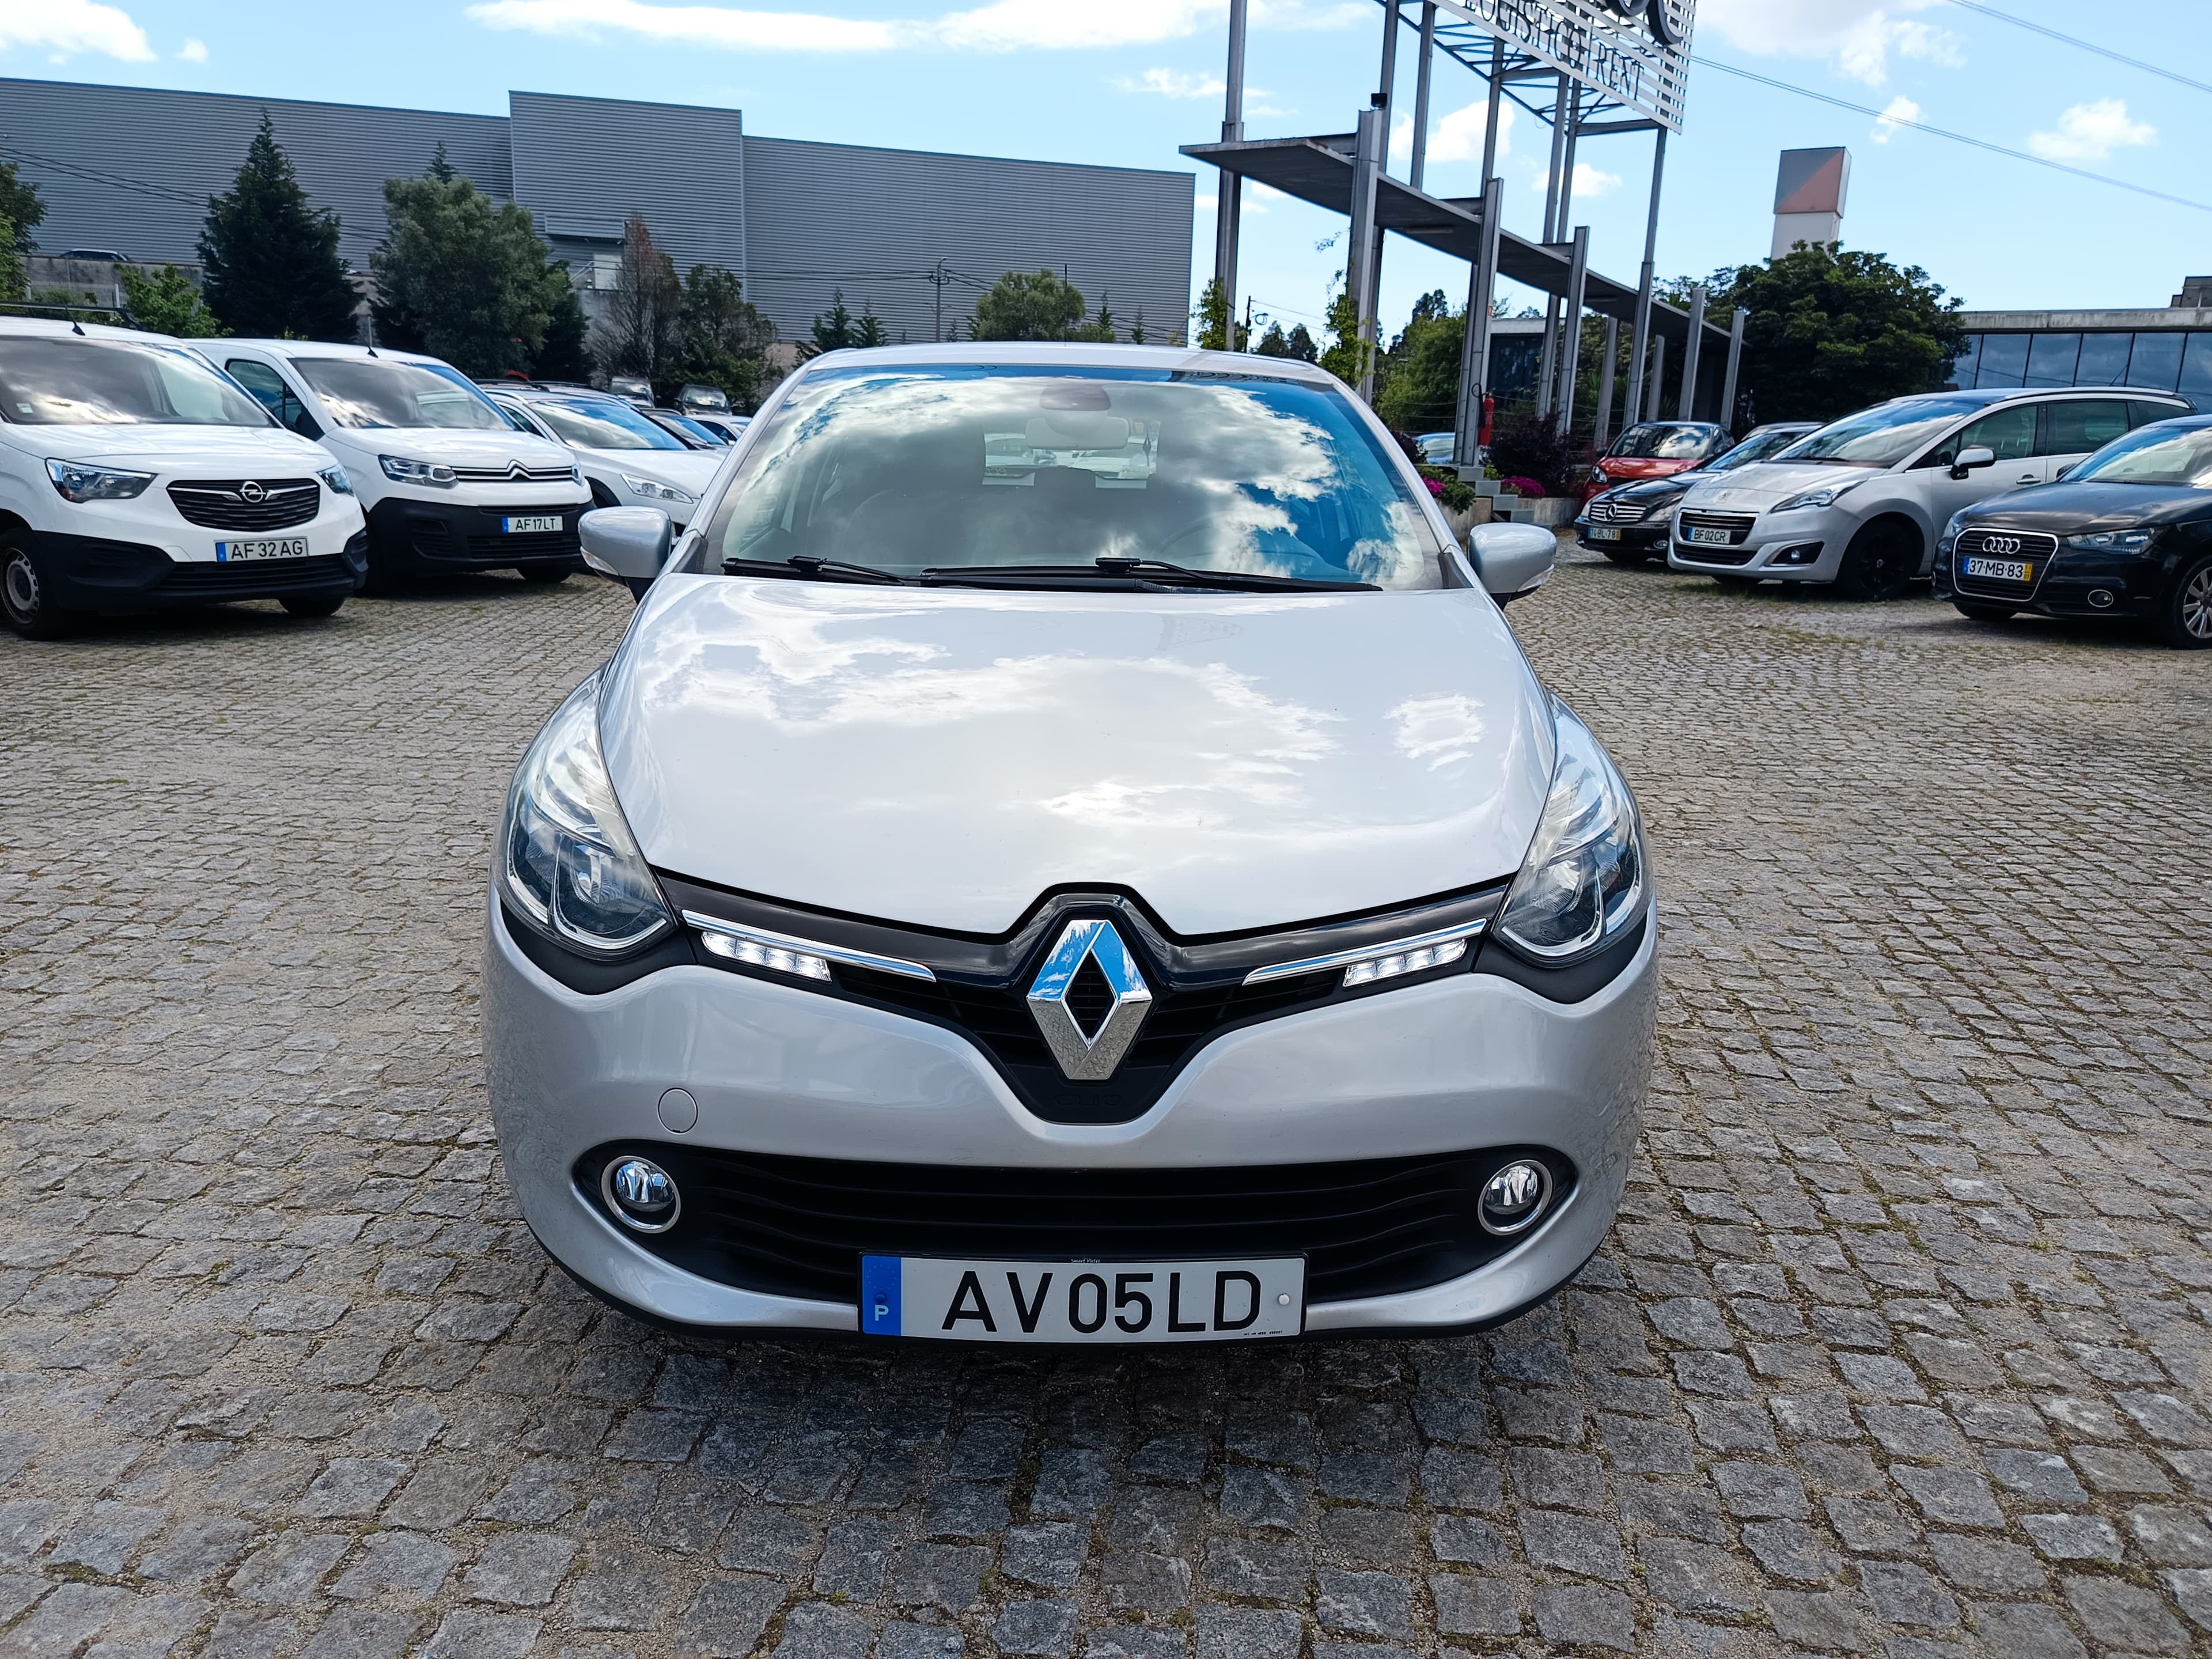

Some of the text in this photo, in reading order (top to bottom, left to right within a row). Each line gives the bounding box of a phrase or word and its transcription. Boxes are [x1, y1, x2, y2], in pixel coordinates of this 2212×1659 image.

[516, 518, 555, 530] AF17LT
[1694, 529, 1726, 541] BF02CR
[875, 1305, 889, 1321] P
